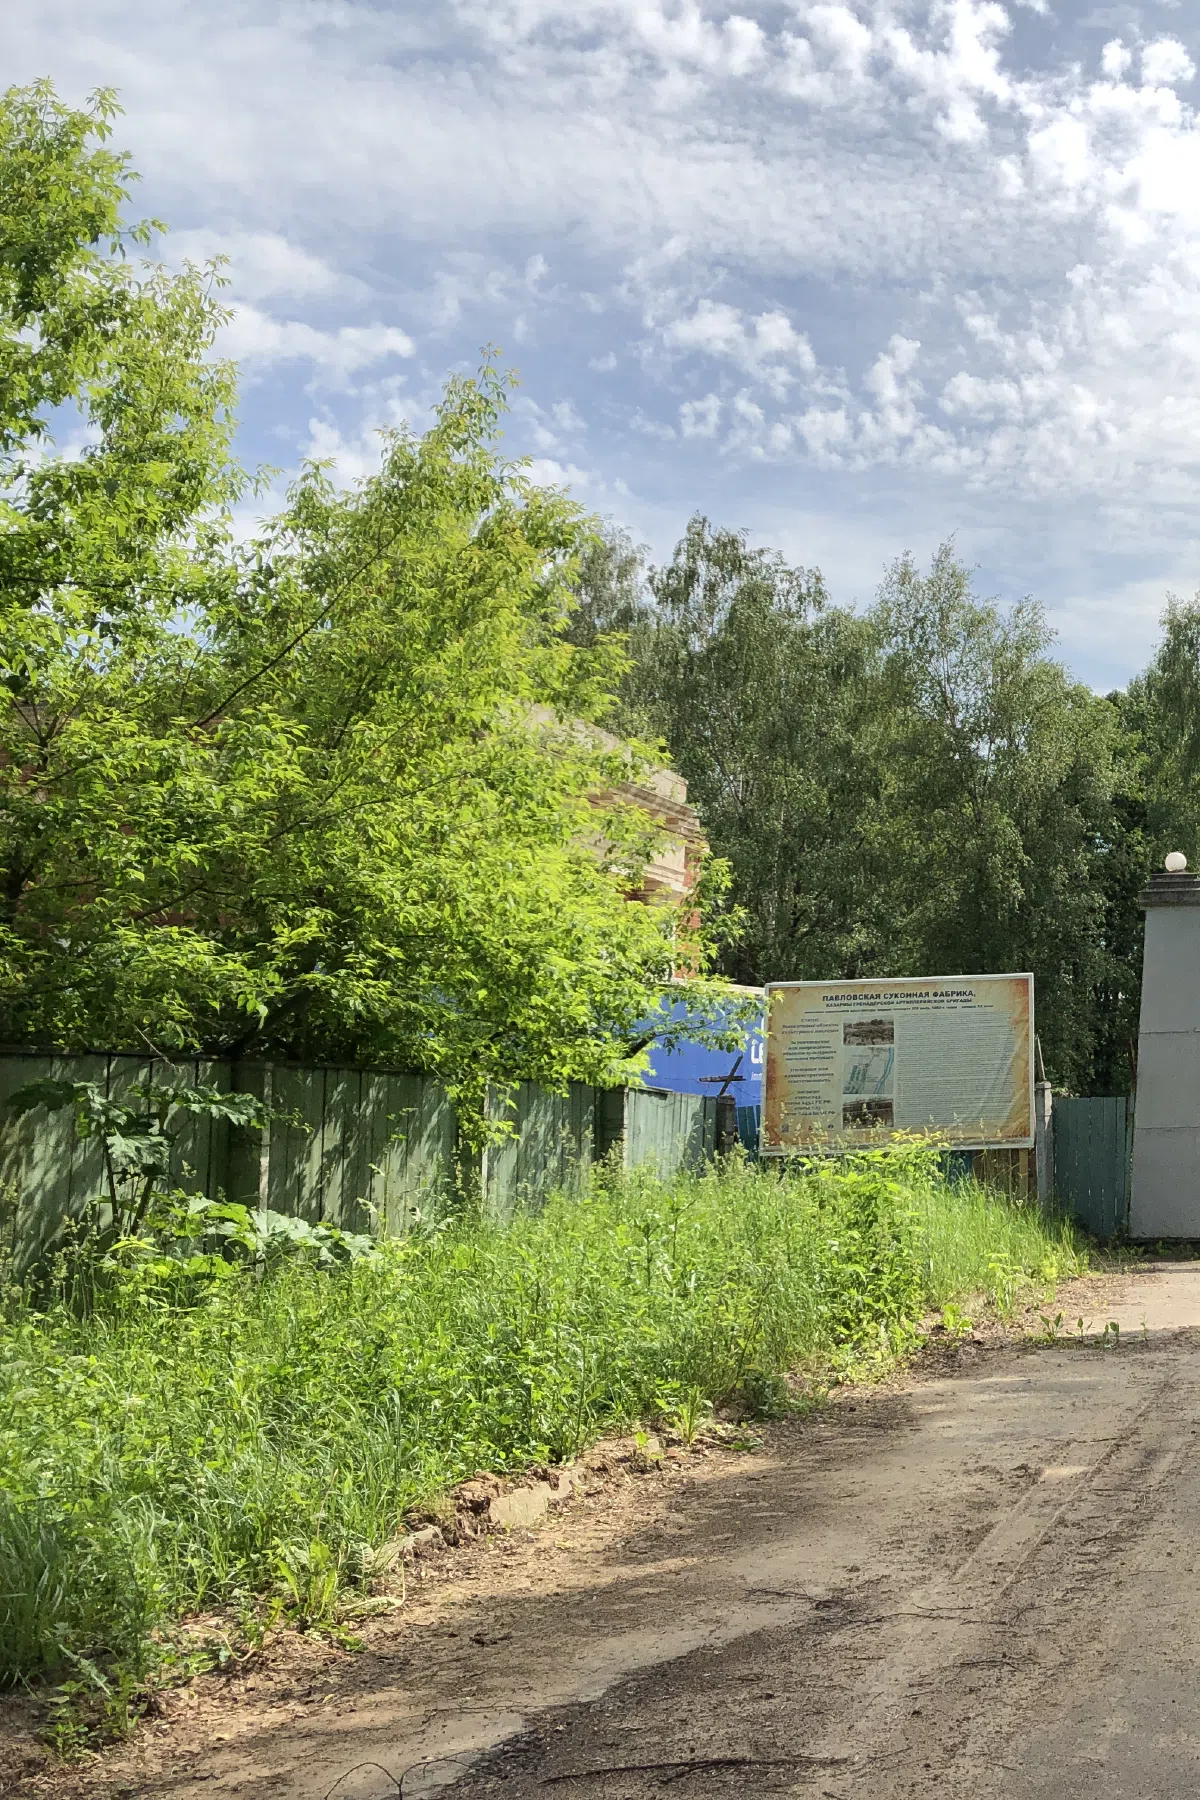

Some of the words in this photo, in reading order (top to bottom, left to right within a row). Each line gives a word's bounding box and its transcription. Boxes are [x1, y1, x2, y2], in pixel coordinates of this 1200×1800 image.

[822, 993, 881, 1001] ПАВЛОВСКАЯ
[883, 991, 929, 999] СУКОННАЯ
[932, 990, 976, 998] ФАБРИКА,
